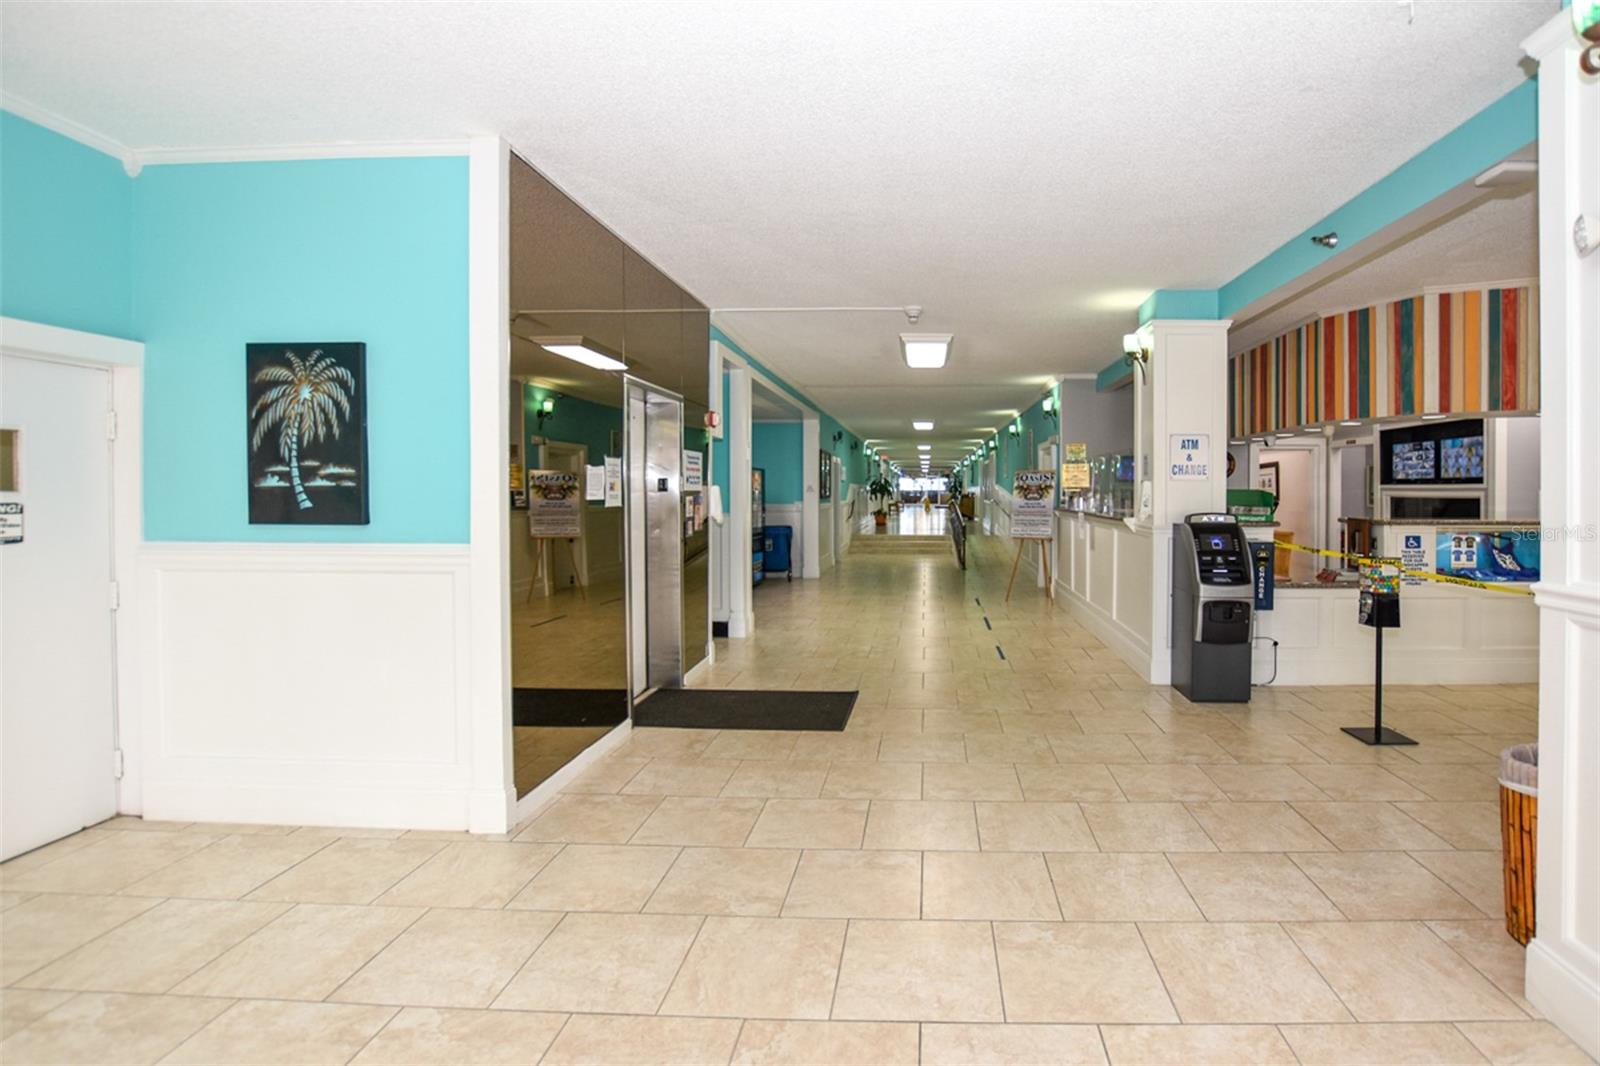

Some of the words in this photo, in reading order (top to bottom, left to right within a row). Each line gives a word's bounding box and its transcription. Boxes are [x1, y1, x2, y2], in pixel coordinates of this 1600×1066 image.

[1180, 439, 1199, 450] ATM
[1186, 453, 1193, 462] &
[1171, 464, 1207, 476] CHANGE
